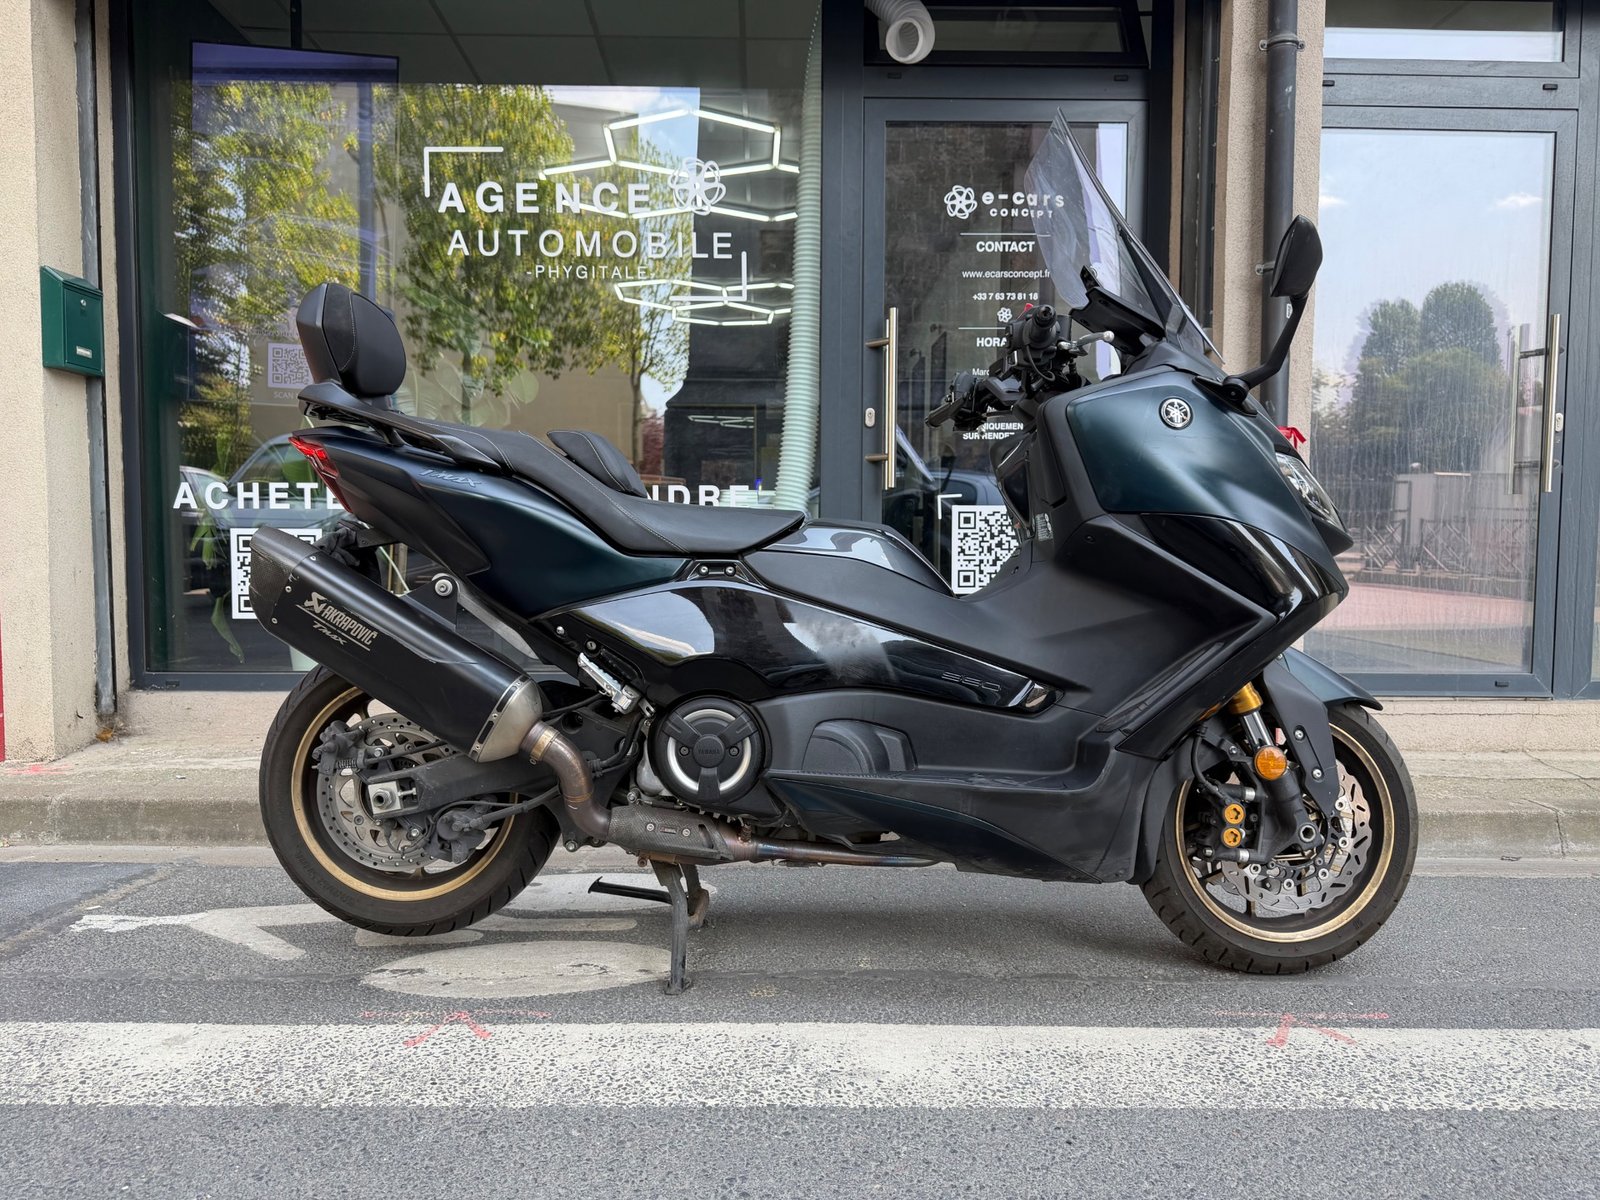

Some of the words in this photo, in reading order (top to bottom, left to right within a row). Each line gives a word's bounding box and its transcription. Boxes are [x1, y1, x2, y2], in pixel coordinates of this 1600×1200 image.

[437, 182, 650, 214] AGENCE
[981, 191, 1065, 208] e-cars
[989, 208, 1053, 219] CONCEPT
[447, 229, 733, 259] AUTOMOBILE
[976, 240, 1035, 253] CONTACT
[961, 269, 1050, 280] www.ecarsconcept.fr
[972, 292, 987, 300] +33
[988, 292, 994, 300] 7
[1006, 292, 1016, 300] 73
